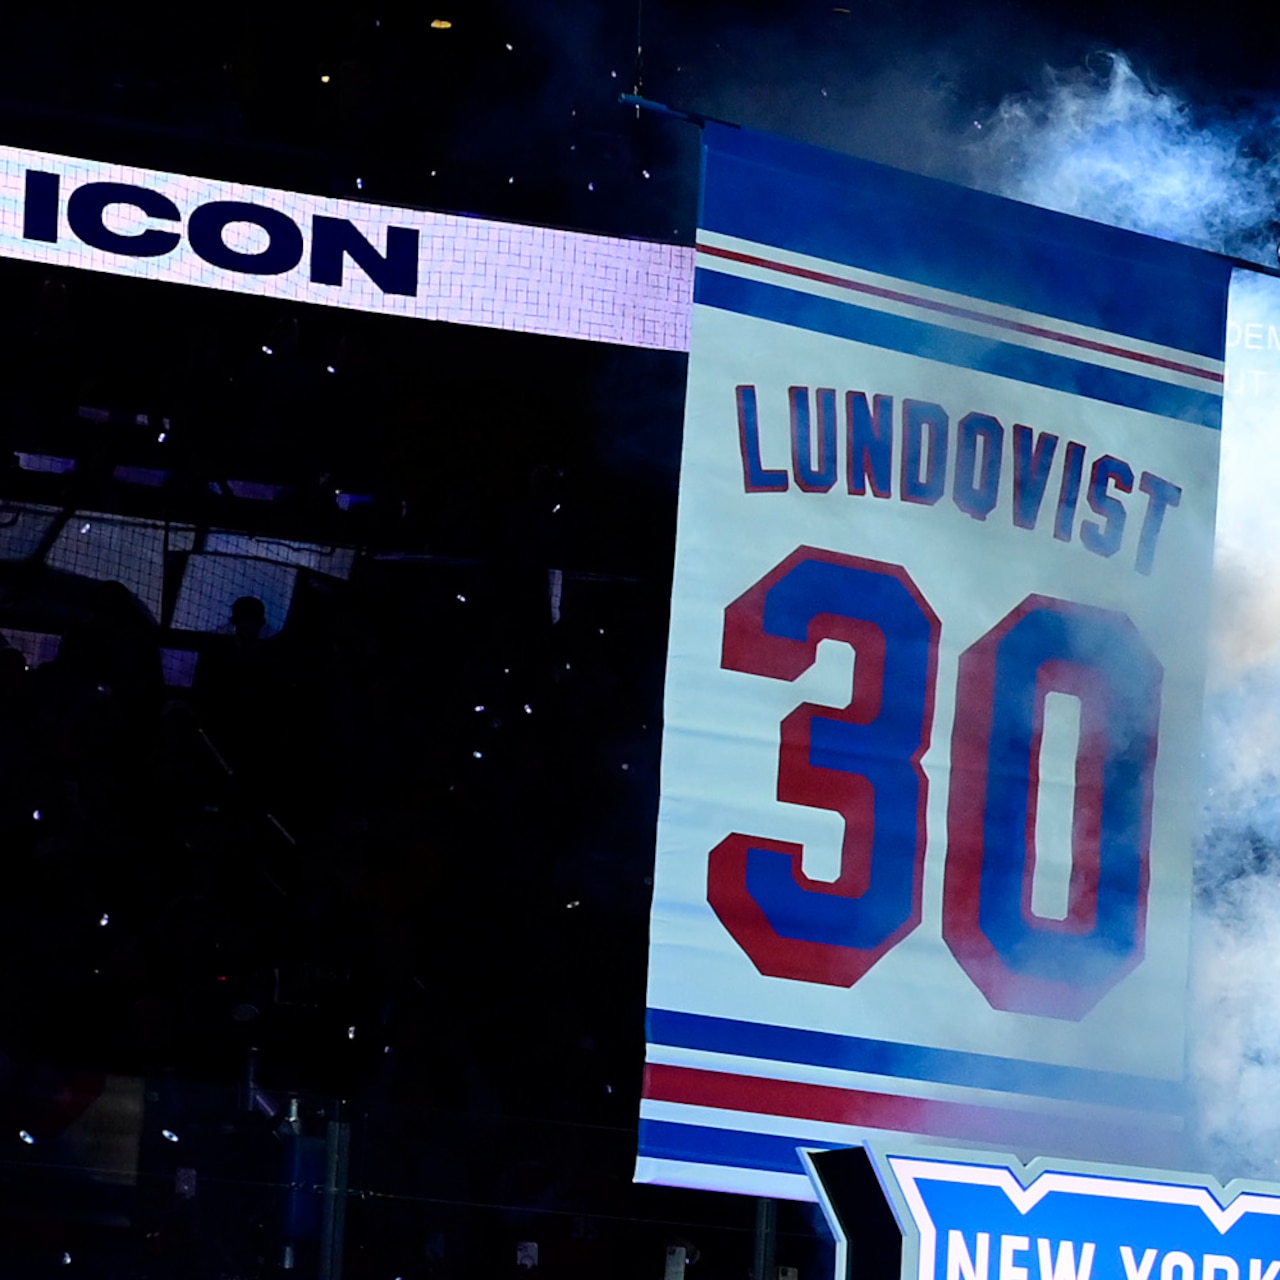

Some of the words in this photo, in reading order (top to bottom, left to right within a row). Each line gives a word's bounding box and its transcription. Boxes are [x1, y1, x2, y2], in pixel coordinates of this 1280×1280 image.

[23, 168, 419, 296] ICON
[735, 384, 1183, 577] LUNDQVIST
[706, 543, 1165, 1022] 30
